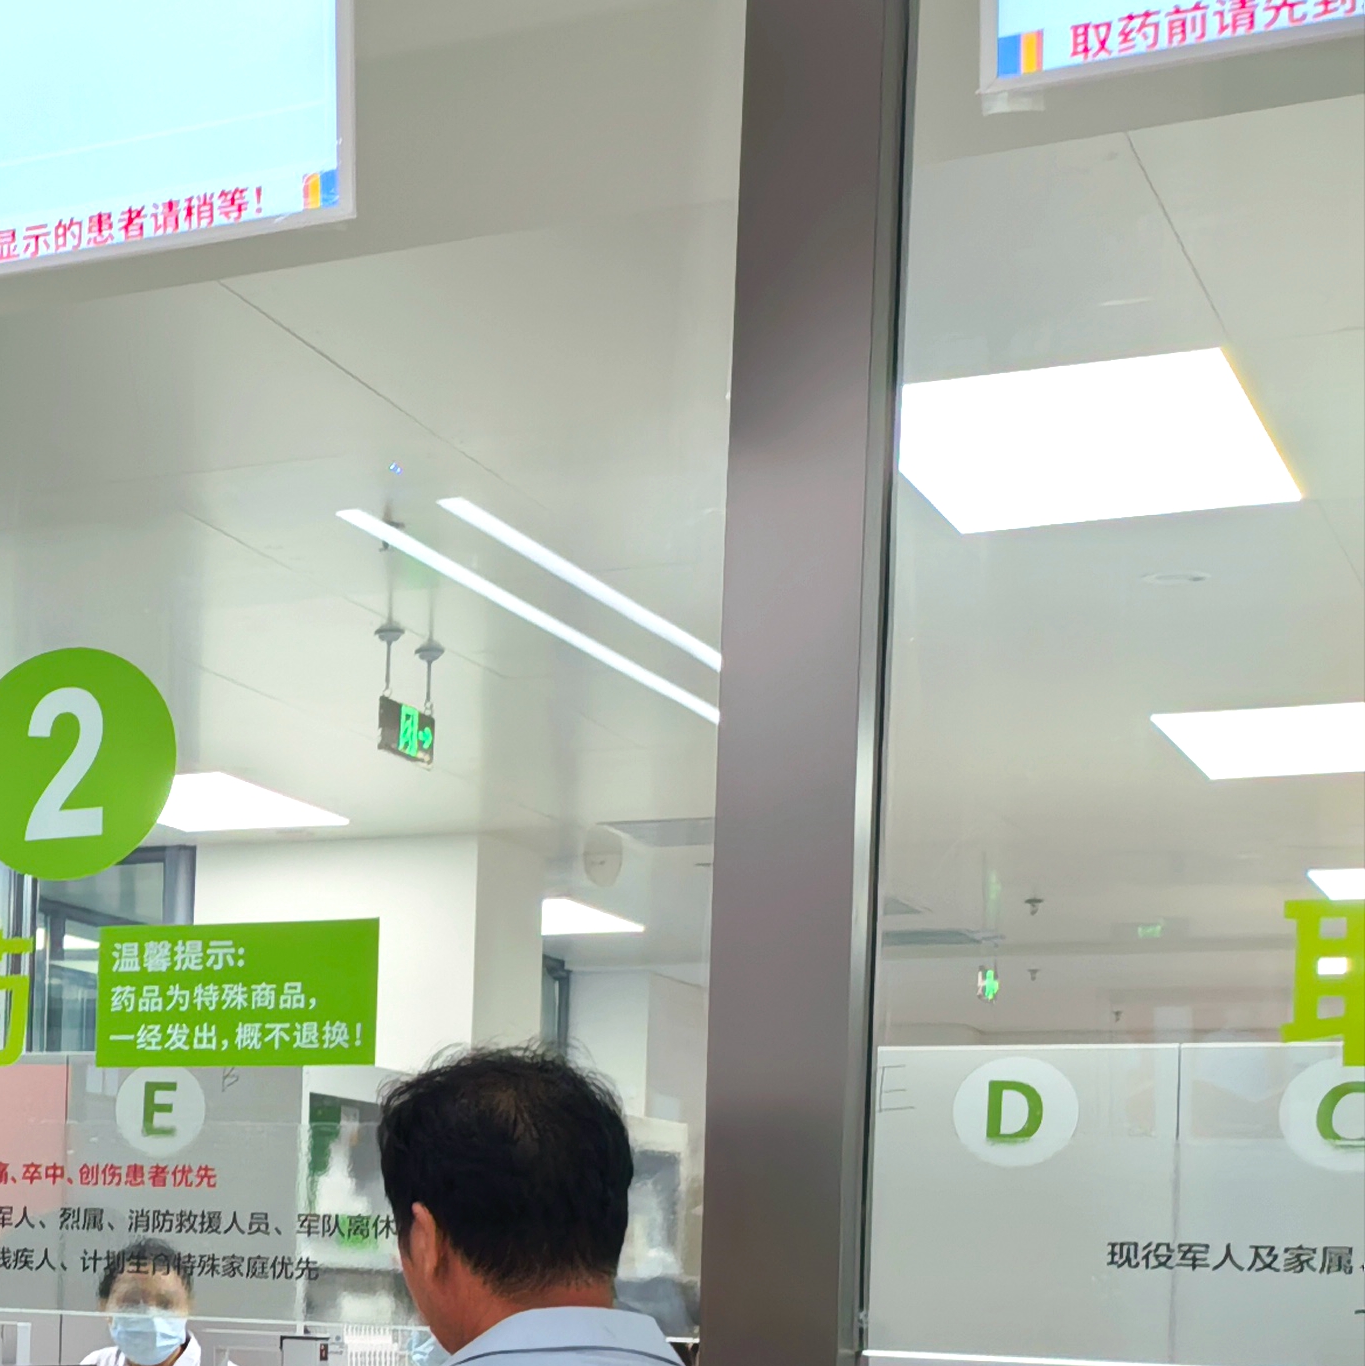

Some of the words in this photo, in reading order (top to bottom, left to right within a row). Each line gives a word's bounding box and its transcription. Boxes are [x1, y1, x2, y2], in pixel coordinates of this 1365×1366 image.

[1070, 0, 1365, 61] 取药前请先
[24, 687, 105, 842] 2
[141, 1081, 178, 1138] E
[986, 1079, 1044, 1144] D
